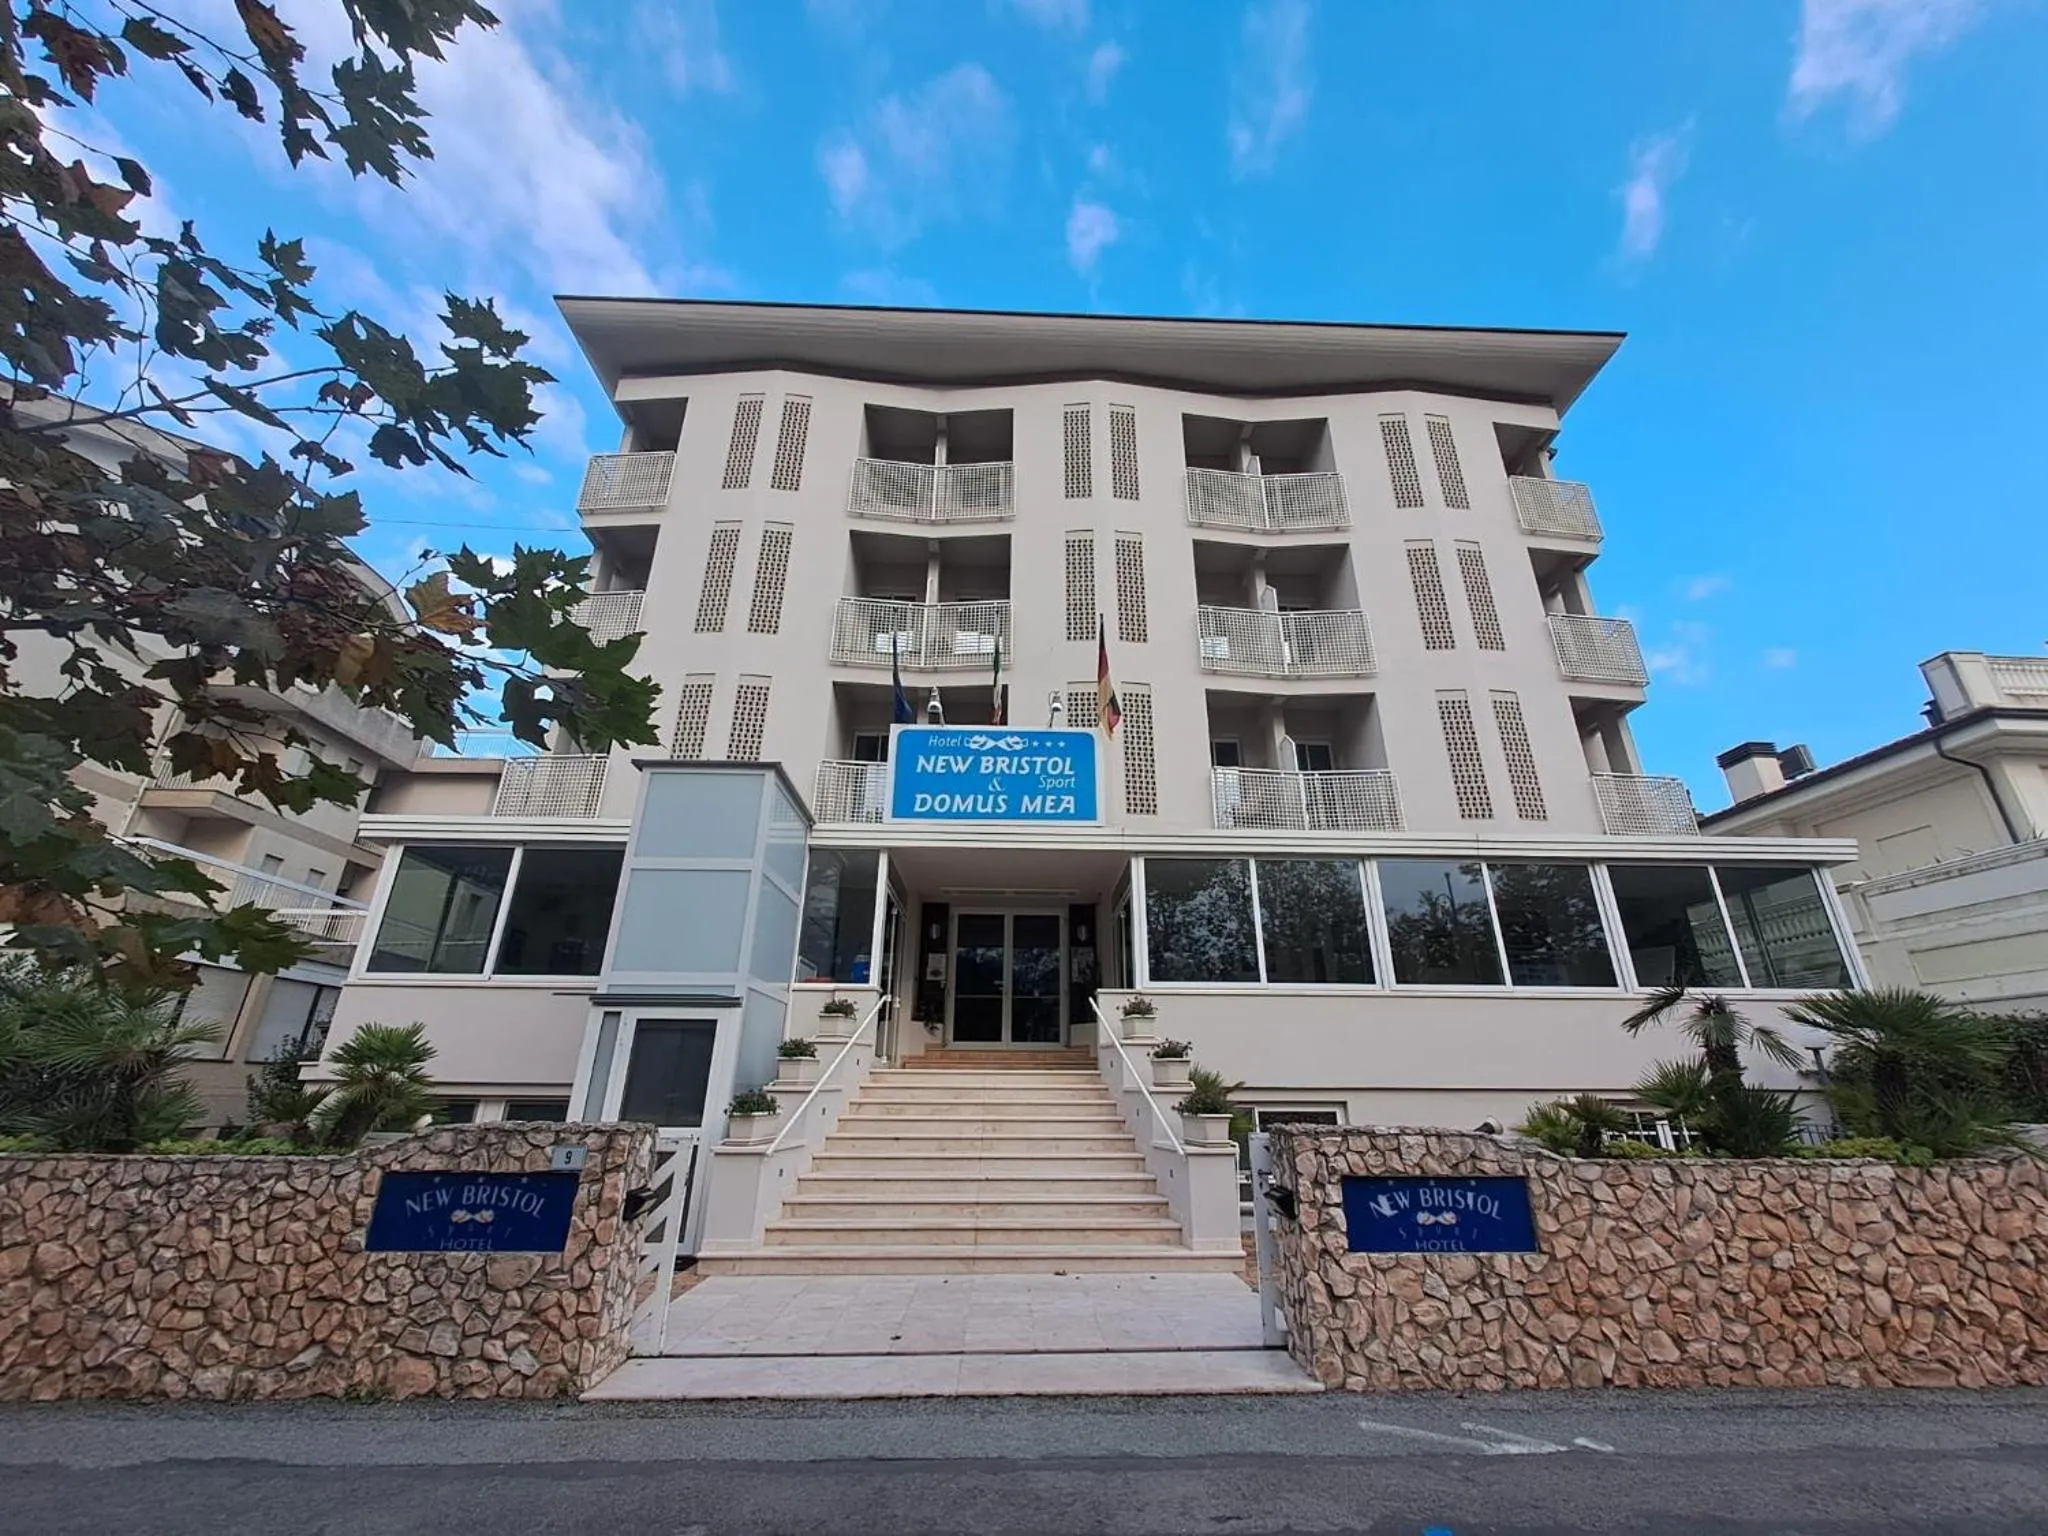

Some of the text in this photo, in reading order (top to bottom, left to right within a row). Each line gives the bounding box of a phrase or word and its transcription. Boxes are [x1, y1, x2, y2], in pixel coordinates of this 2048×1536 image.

[928, 735, 961, 748] Hotel
[916, 755, 1075, 776] NEW BRISTOL
[988, 777, 1005, 792] &
[1038, 775, 1075, 791] Sport
[914, 793, 1075, 814] DOMUS MEA
[563, 1150, 573, 1165] 9
[405, 1184, 549, 1219] NEW BRISTOL
[1368, 1187, 1503, 1220] NEW BRISTOL
[439, 1237, 494, 1250] HOTEL
[1415, 1239, 1467, 1251] HOTEL
